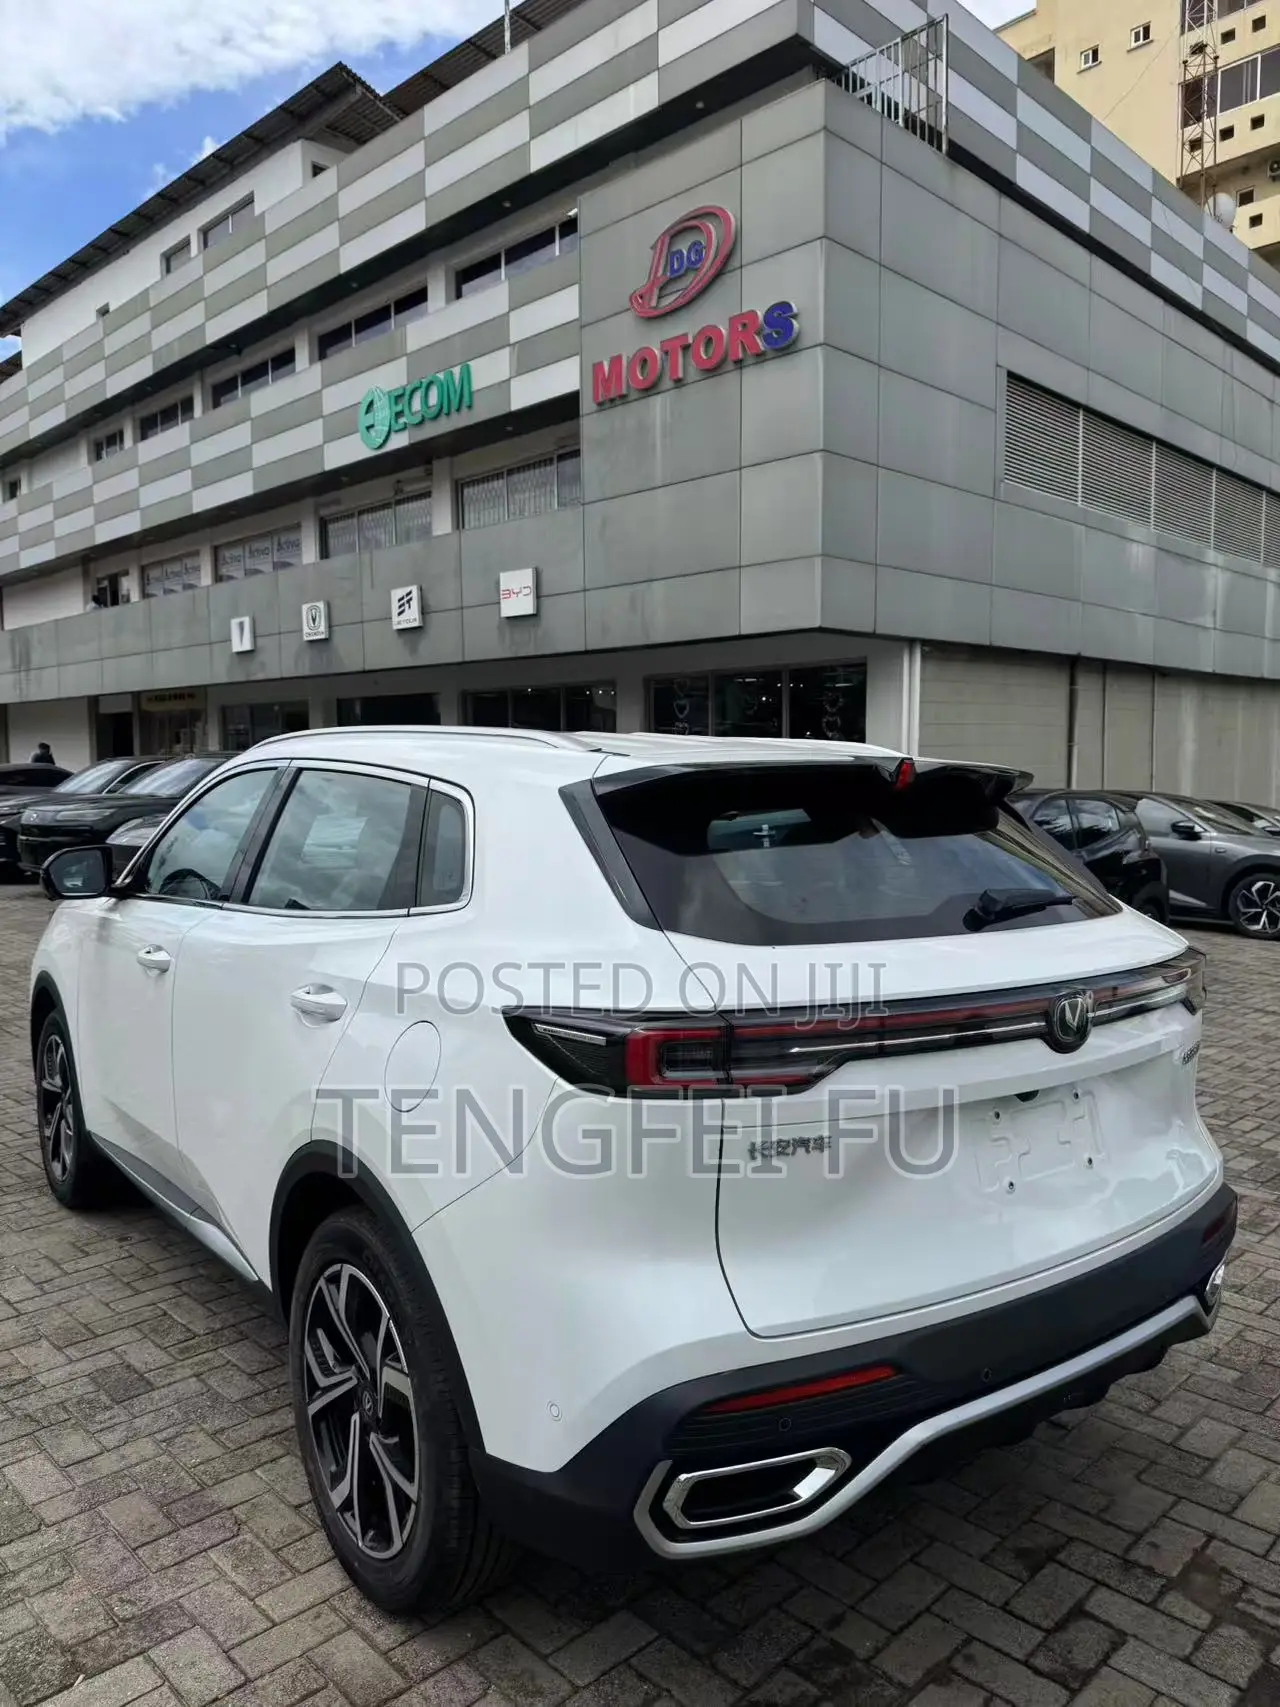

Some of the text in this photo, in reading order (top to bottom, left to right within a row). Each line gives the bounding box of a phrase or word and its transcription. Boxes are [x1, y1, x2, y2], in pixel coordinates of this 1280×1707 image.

[667, 240, 706, 279] DG
[592, 301, 800, 406] MOTORS
[501, 585, 532, 600] BYD
